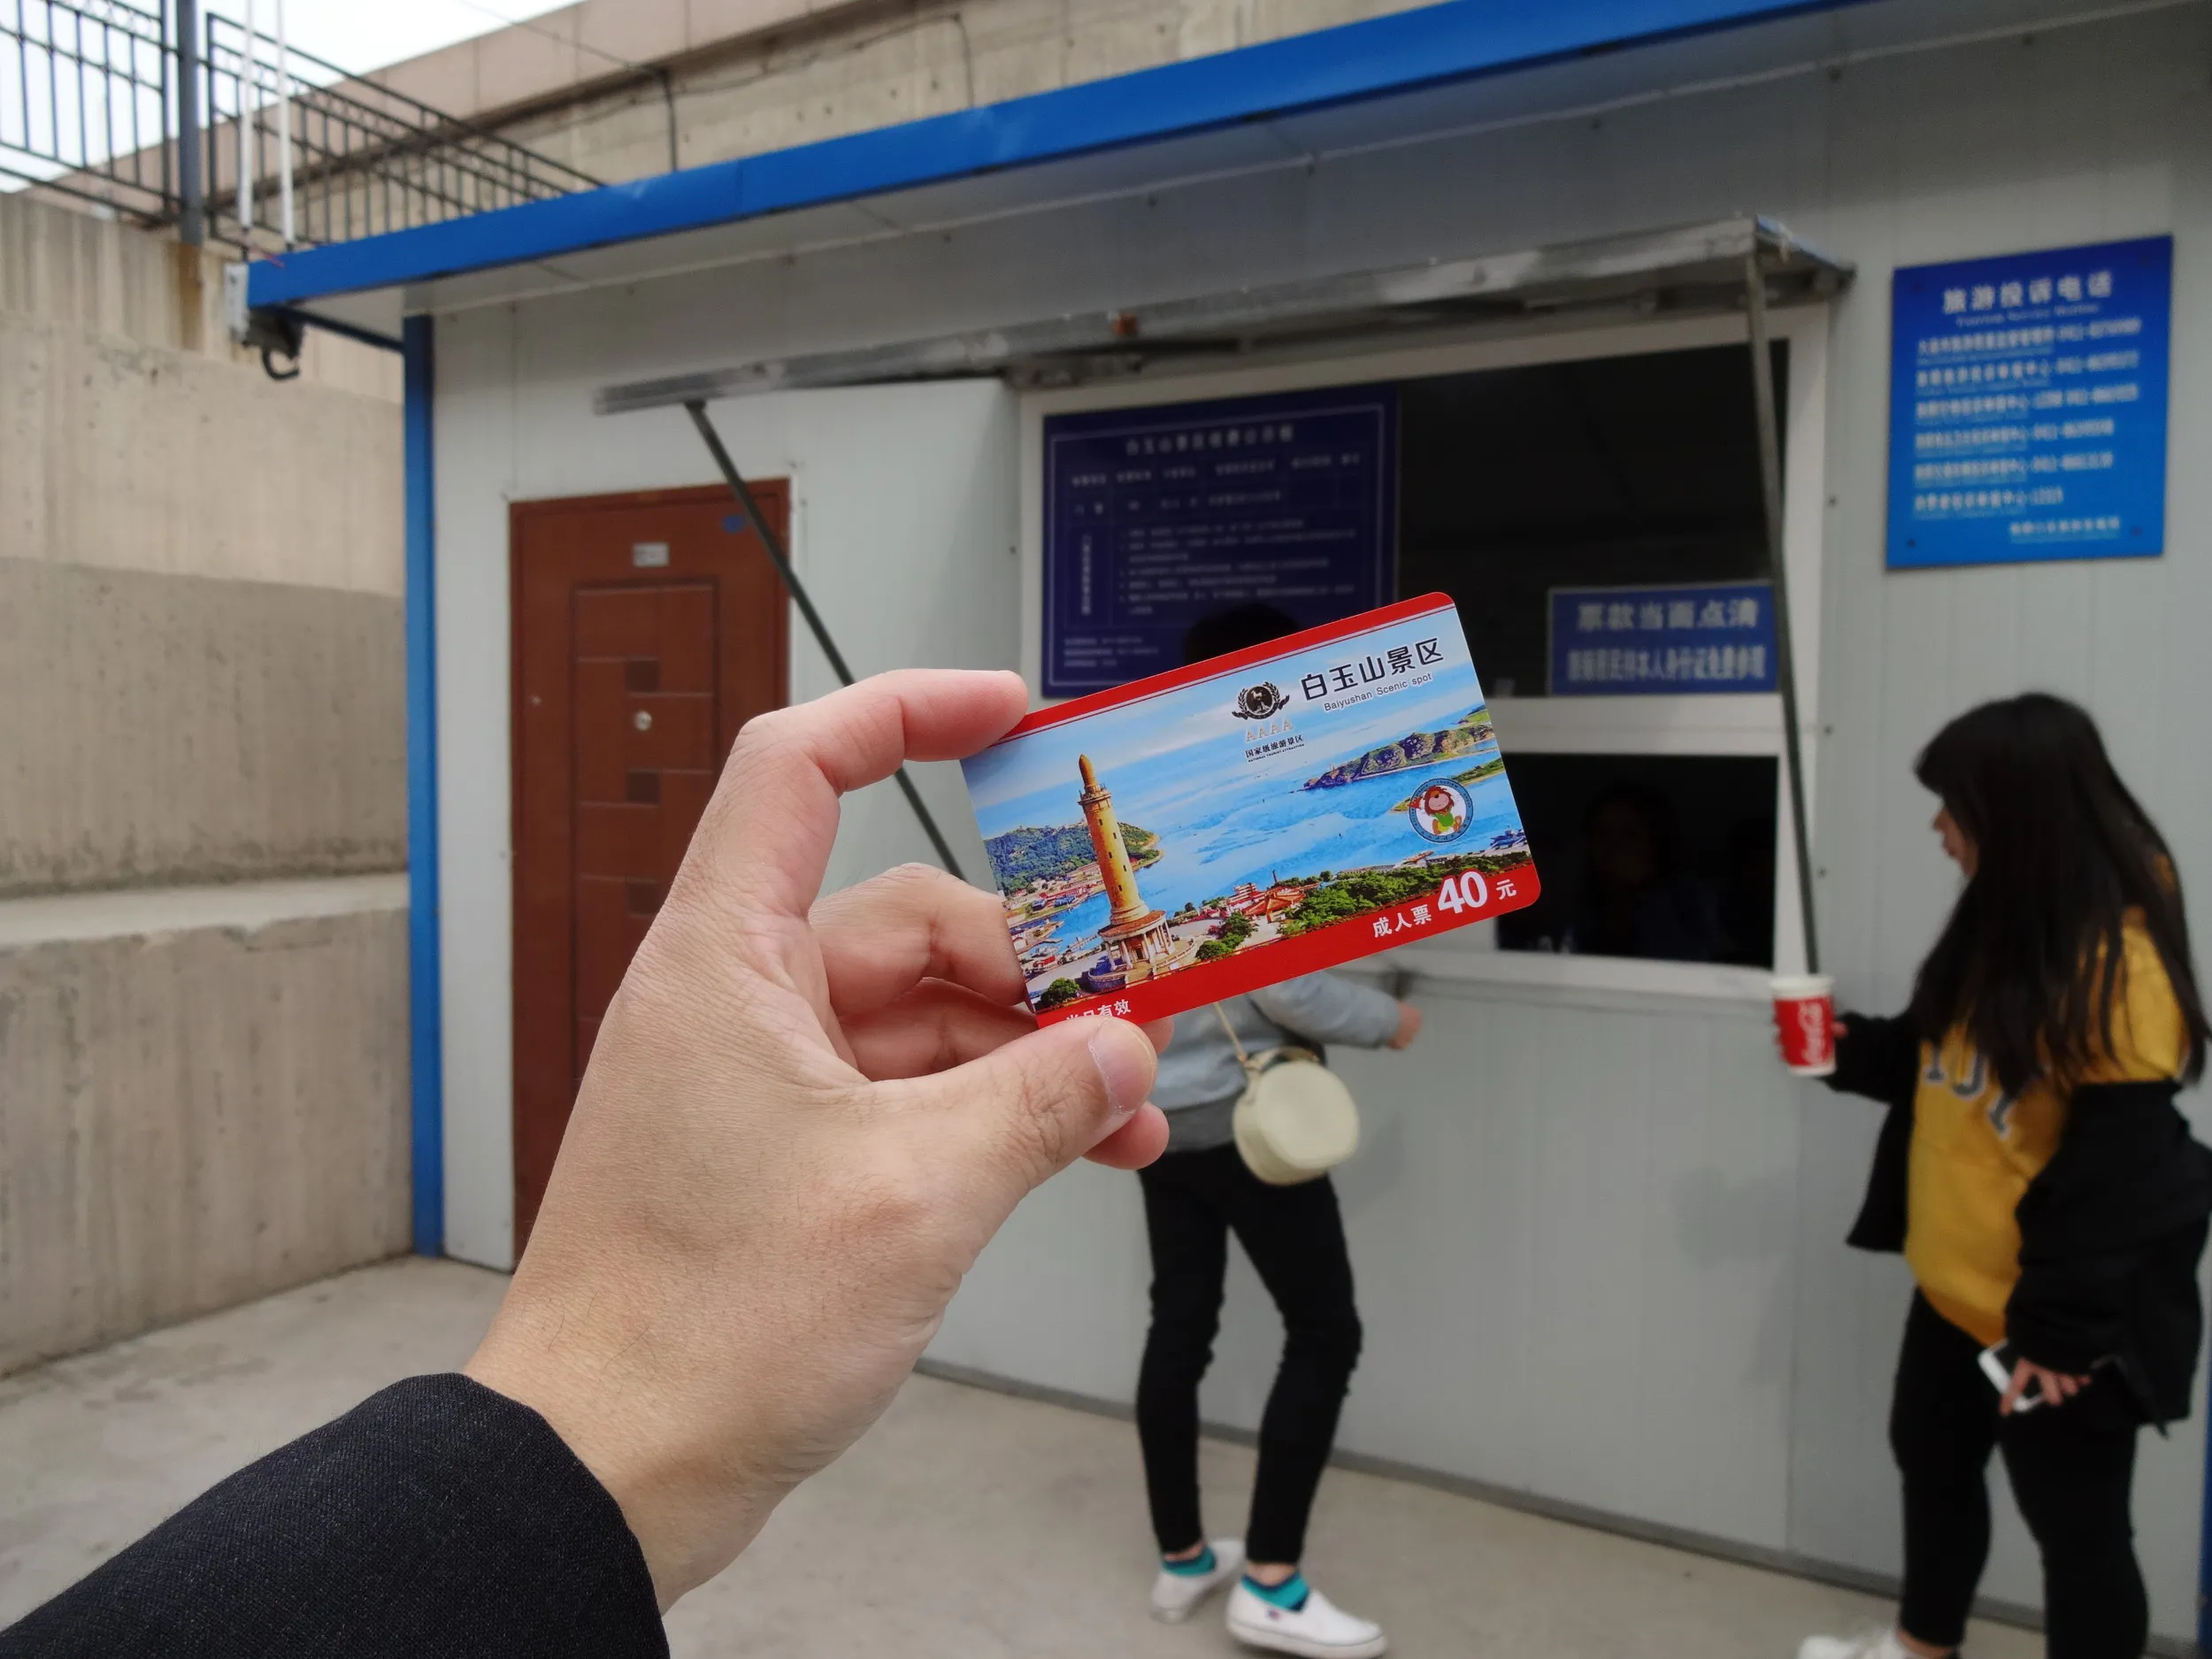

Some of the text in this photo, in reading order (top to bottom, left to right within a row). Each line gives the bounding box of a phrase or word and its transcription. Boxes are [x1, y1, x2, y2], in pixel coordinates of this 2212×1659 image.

[1301, 637, 1444, 701] 白玉山景区
[1324, 672, 1432, 711] Baiyushan Scenic spot
[1246, 734, 1303, 757] 国家级旅游景区
[1372, 871, 1517, 938] 成人票 40 元
